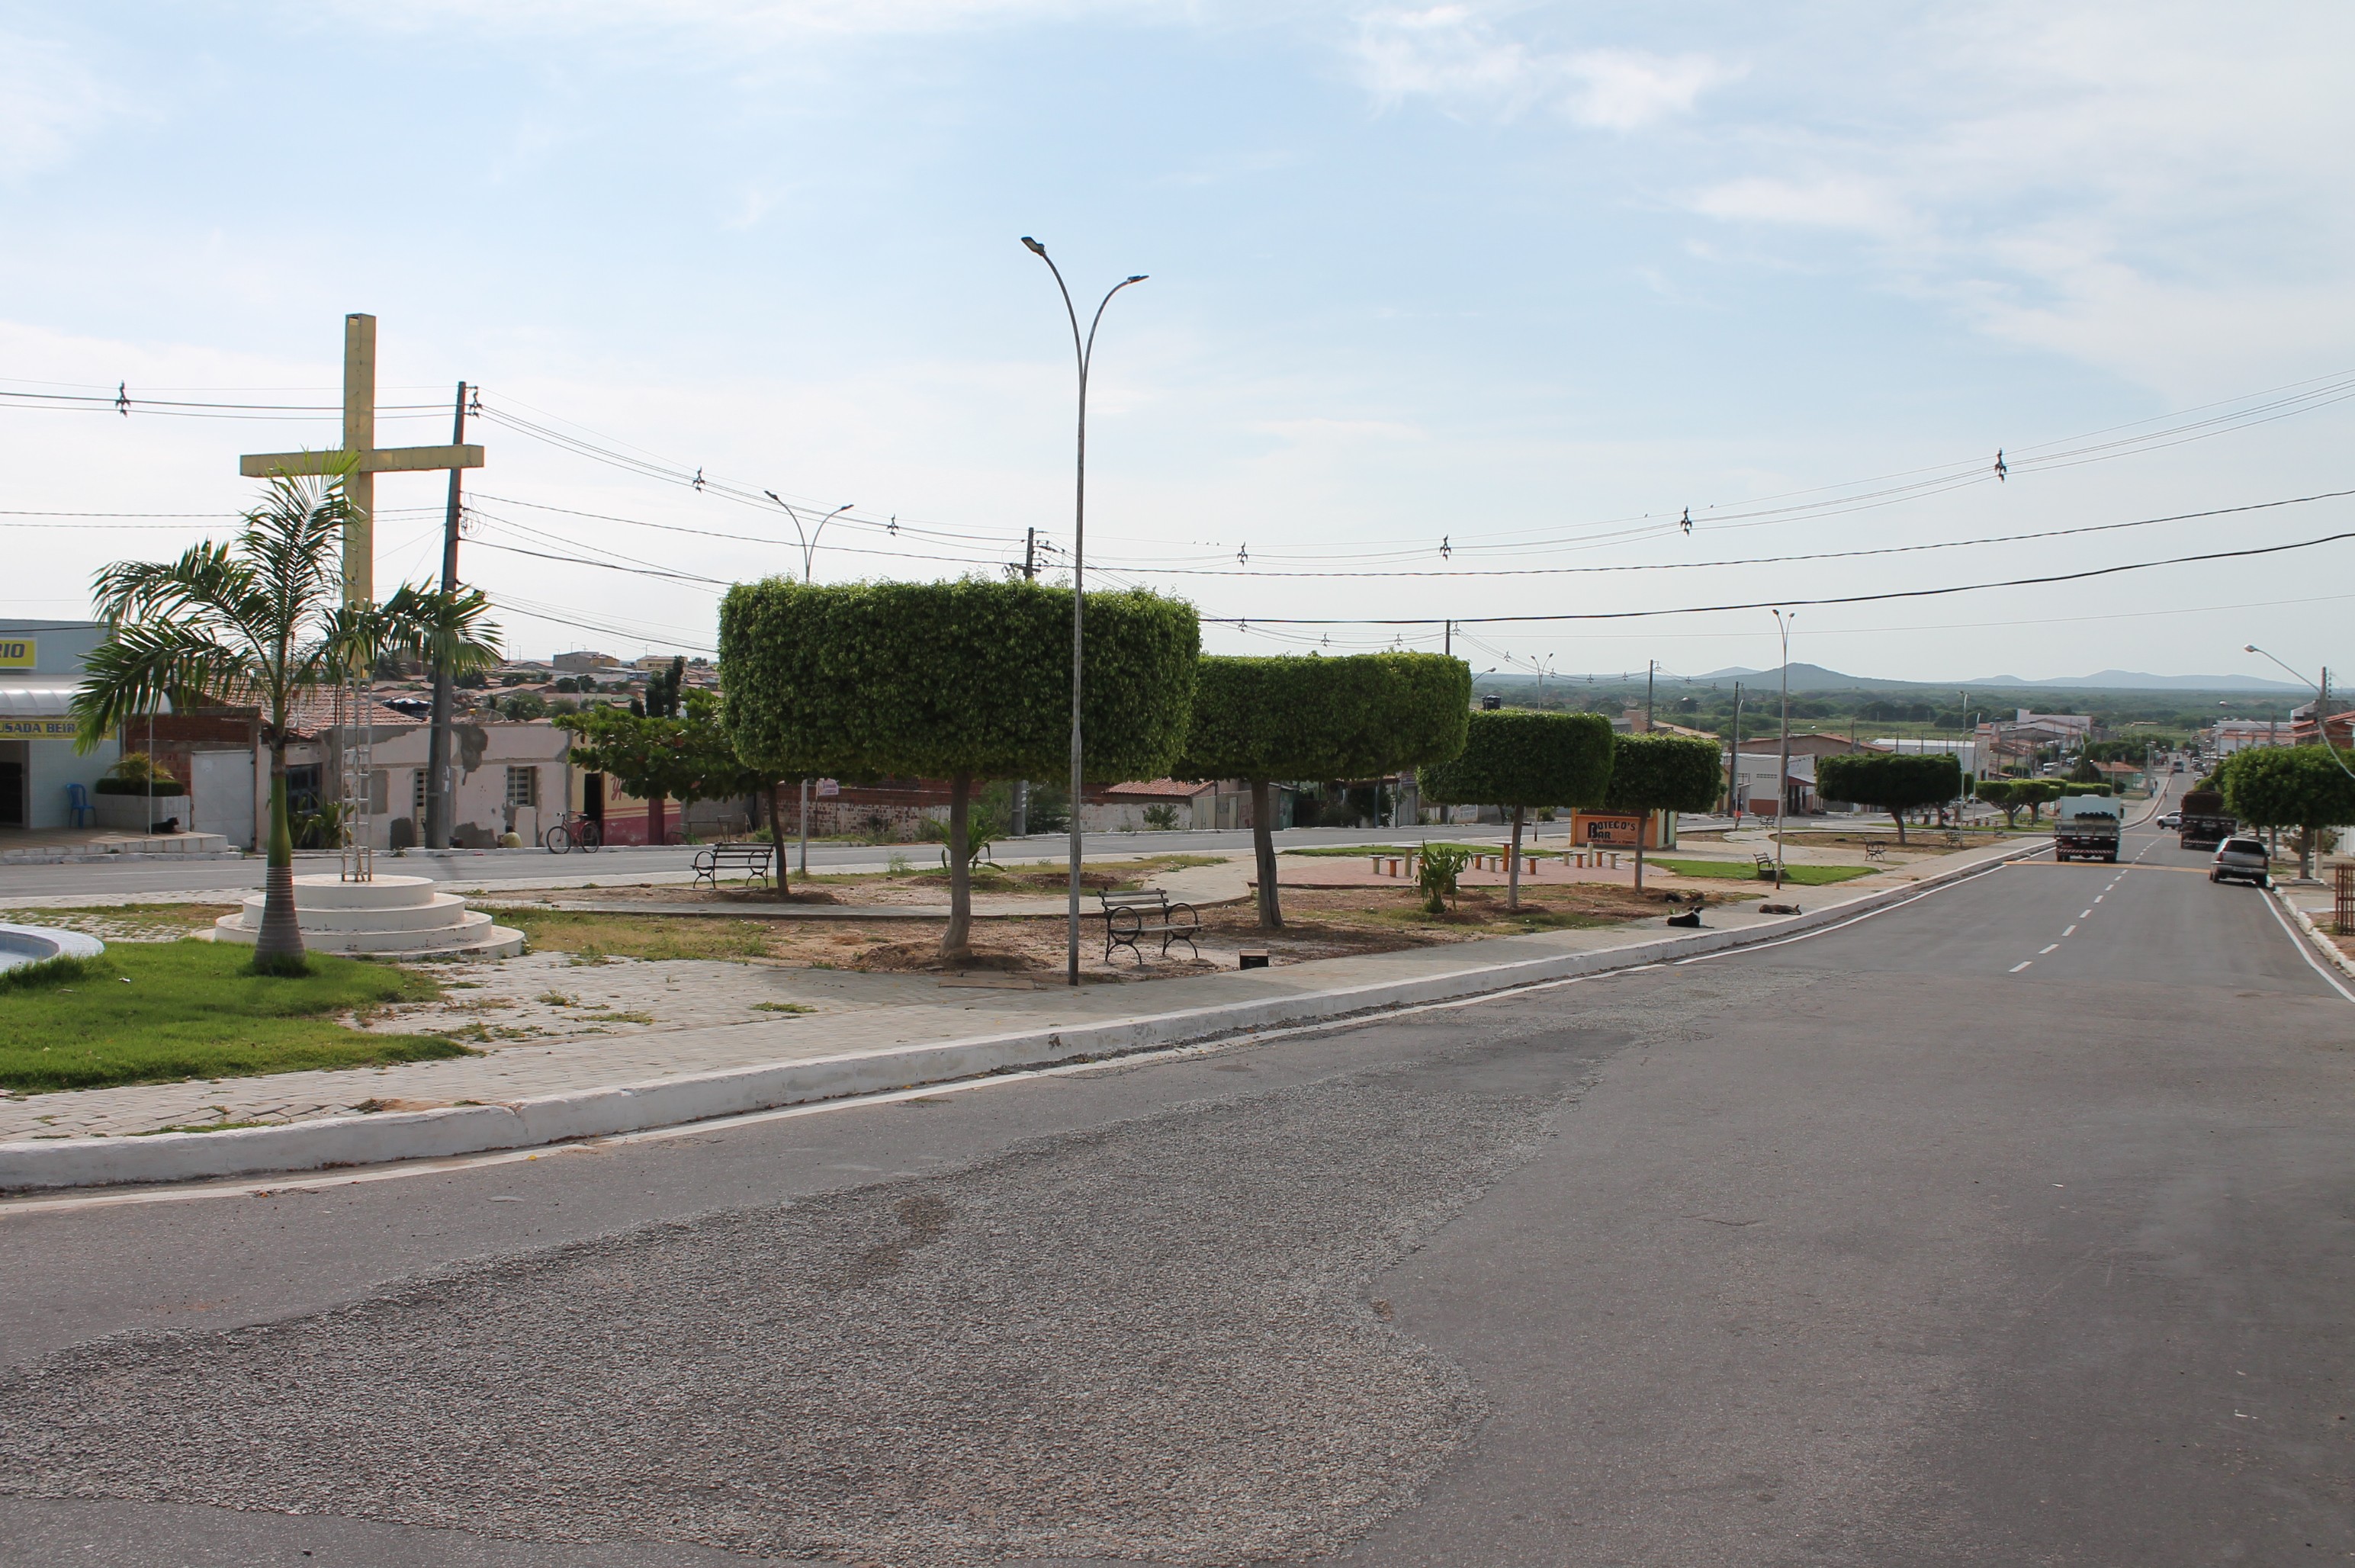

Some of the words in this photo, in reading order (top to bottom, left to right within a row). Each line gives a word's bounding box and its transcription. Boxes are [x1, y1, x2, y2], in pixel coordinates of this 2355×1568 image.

[47, 723, 85, 733] BEIR
[1587, 821, 1636, 838] BOTECO'S
[1587, 825, 1611, 839] BAR
